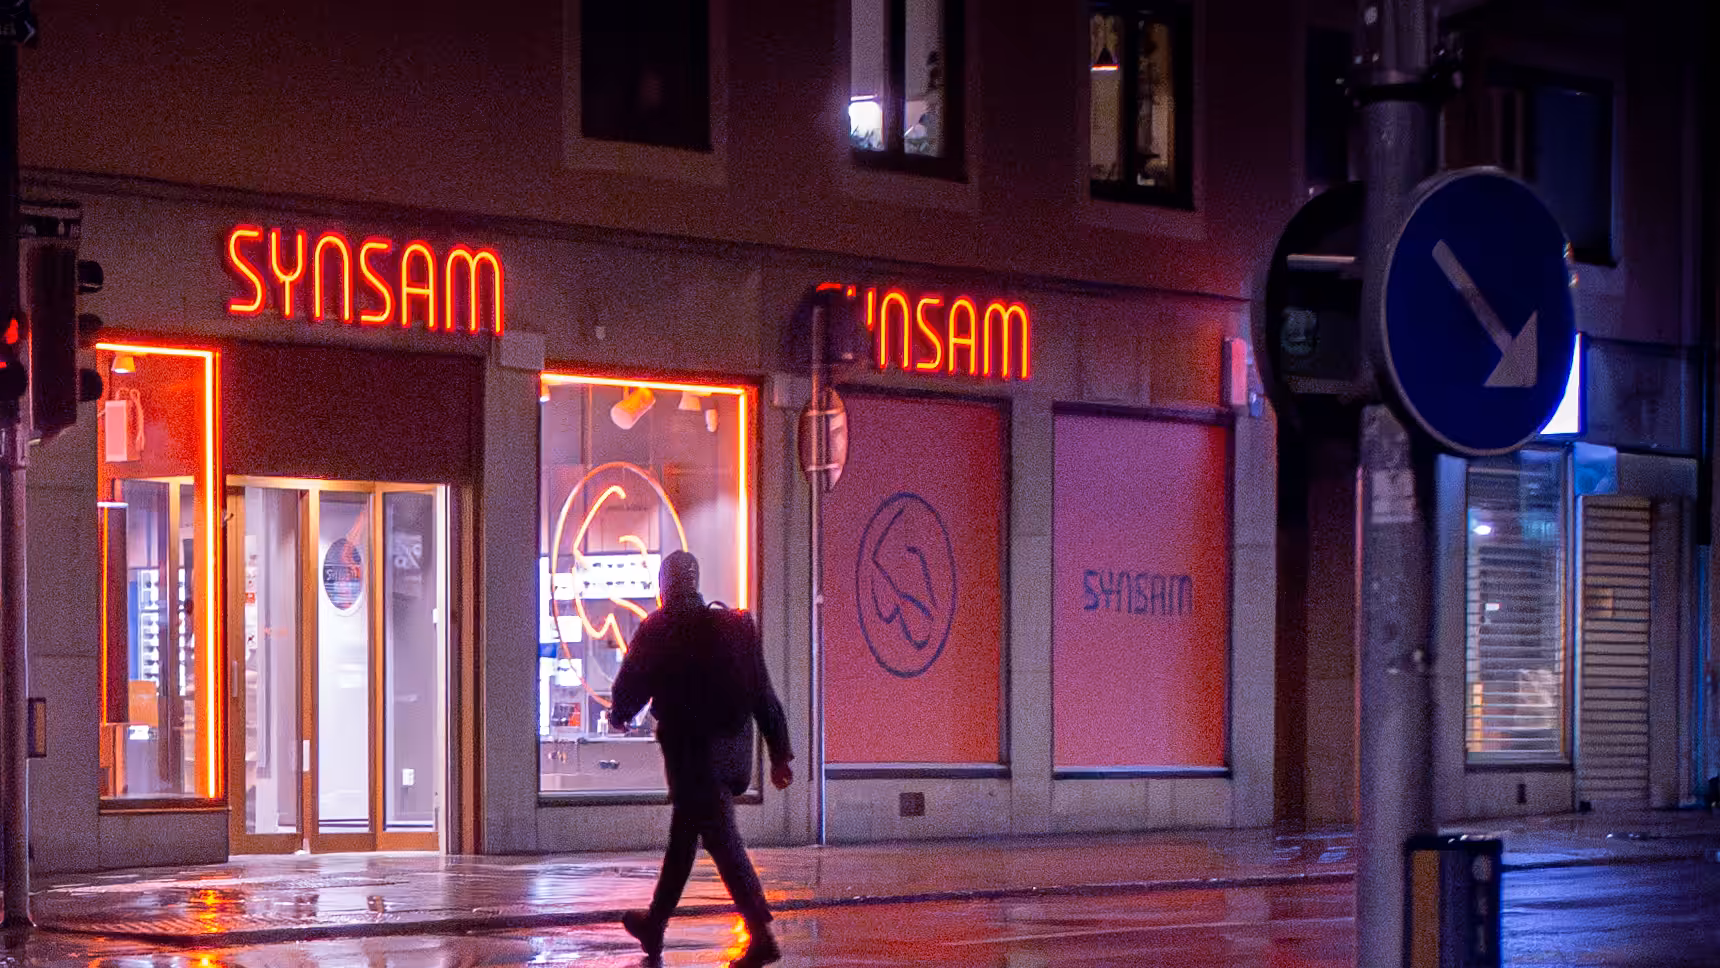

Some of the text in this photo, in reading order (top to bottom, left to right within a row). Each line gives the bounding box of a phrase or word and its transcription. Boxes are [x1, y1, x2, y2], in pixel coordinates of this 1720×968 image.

[227, 224, 504, 335] SYNSAM
[816, 282, 1032, 381] NSAM
[1083, 569, 1193, 616] SYNSAM
